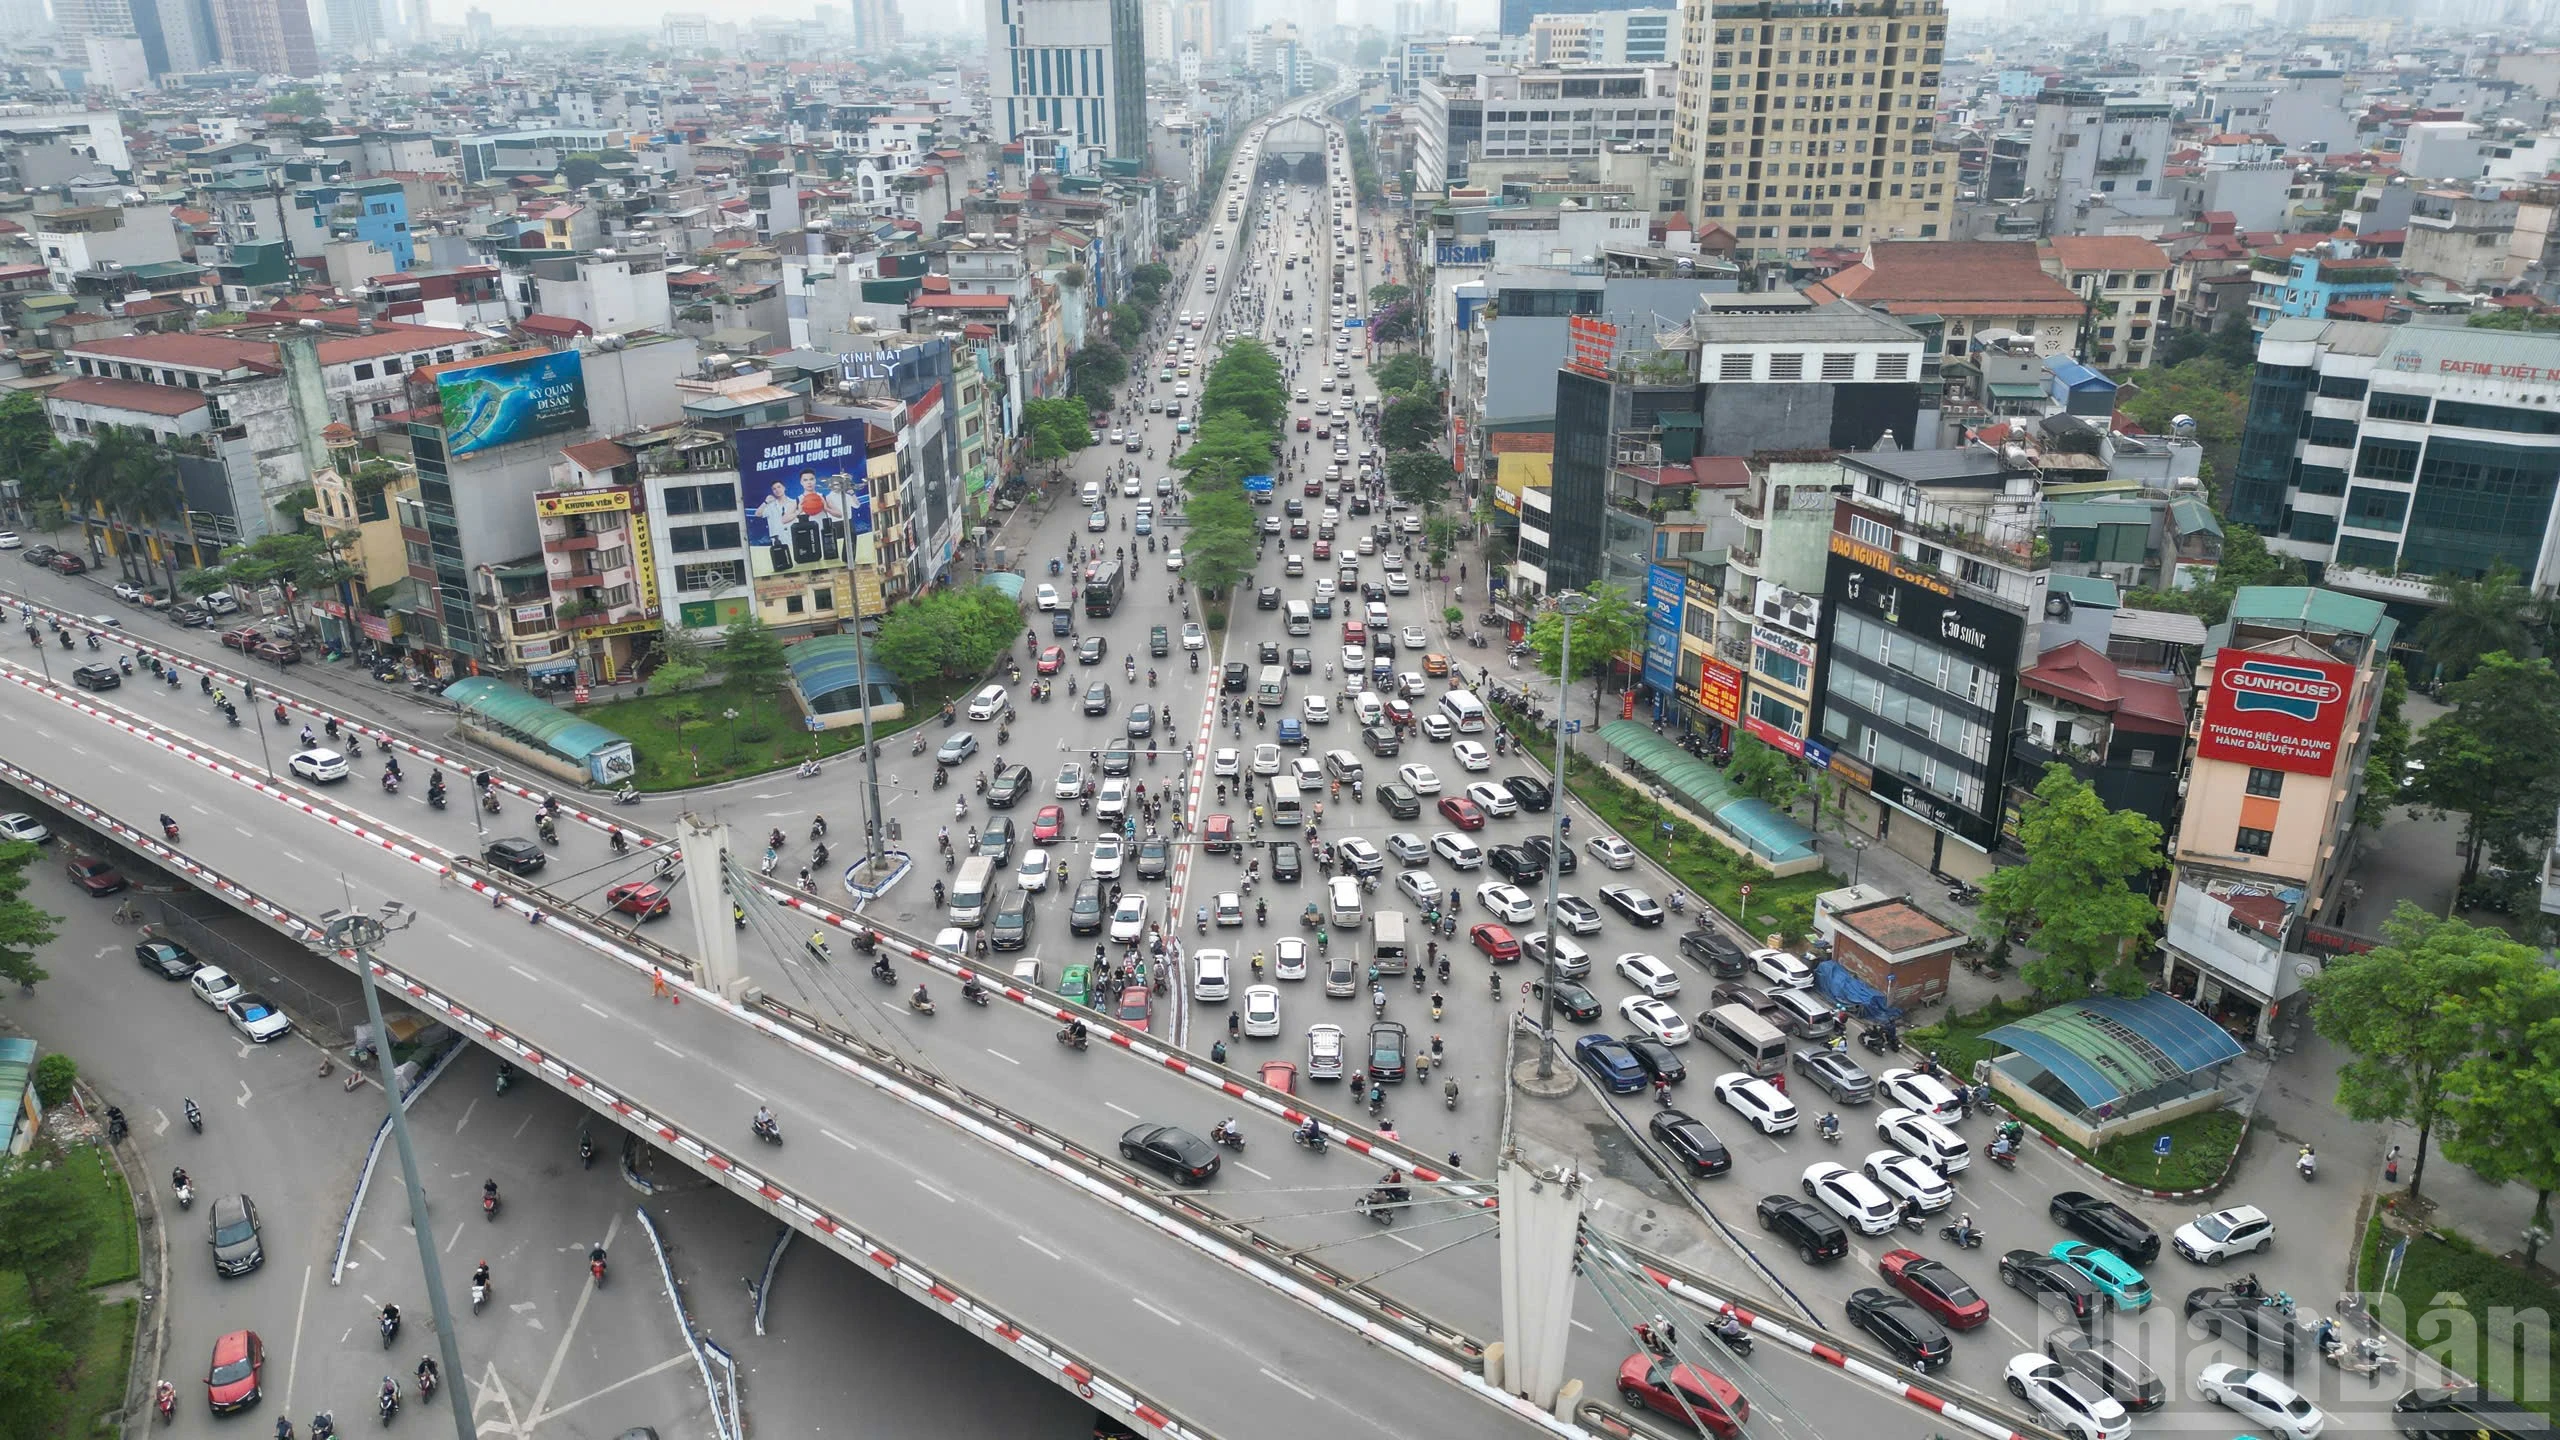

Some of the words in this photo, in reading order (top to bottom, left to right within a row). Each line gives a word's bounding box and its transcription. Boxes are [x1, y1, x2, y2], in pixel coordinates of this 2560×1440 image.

[845, 362, 900, 380] LILY
[545, 383, 574, 398] QUAN
[783, 428, 803, 437] RHYS
[804, 426, 822, 435] MAN
[764, 443, 791, 459] SẠCH
[794, 438, 822, 453] THƠM
[825, 433, 842, 448] RỒI
[756, 458, 785, 472] READY
[787, 455, 804, 467] MỌI
[806, 449, 830, 463] CUỘC
[832, 445, 853, 458] CHƠI
[565, 501, 595, 510] KHƯƠNG
[596, 498, 612, 506] VIÊN
[636, 518, 649, 564] KHƯƠNG
[644, 566, 655, 596] VIÊN
[1852, 544, 1890, 572] NGUYÊN
[1893, 566, 1949, 596] Coffee
[647, 606, 659, 615] 341
[1948, 622, 1959, 638] 30
[2233, 674, 2330, 698] SUNHOUSE
[2210, 723, 2253, 738] THƯƠNG
[2254, 729, 2280, 742] HIỆU
[2280, 735, 2299, 745] GIA
[2300, 738, 2331, 750] DỤNG
[2216, 735, 2245, 748] HÀNG
[2246, 738, 2269, 751] ĐẦU
[2271, 743, 2294, 756] VIỆT
[2295, 748, 2321, 760] NAM
